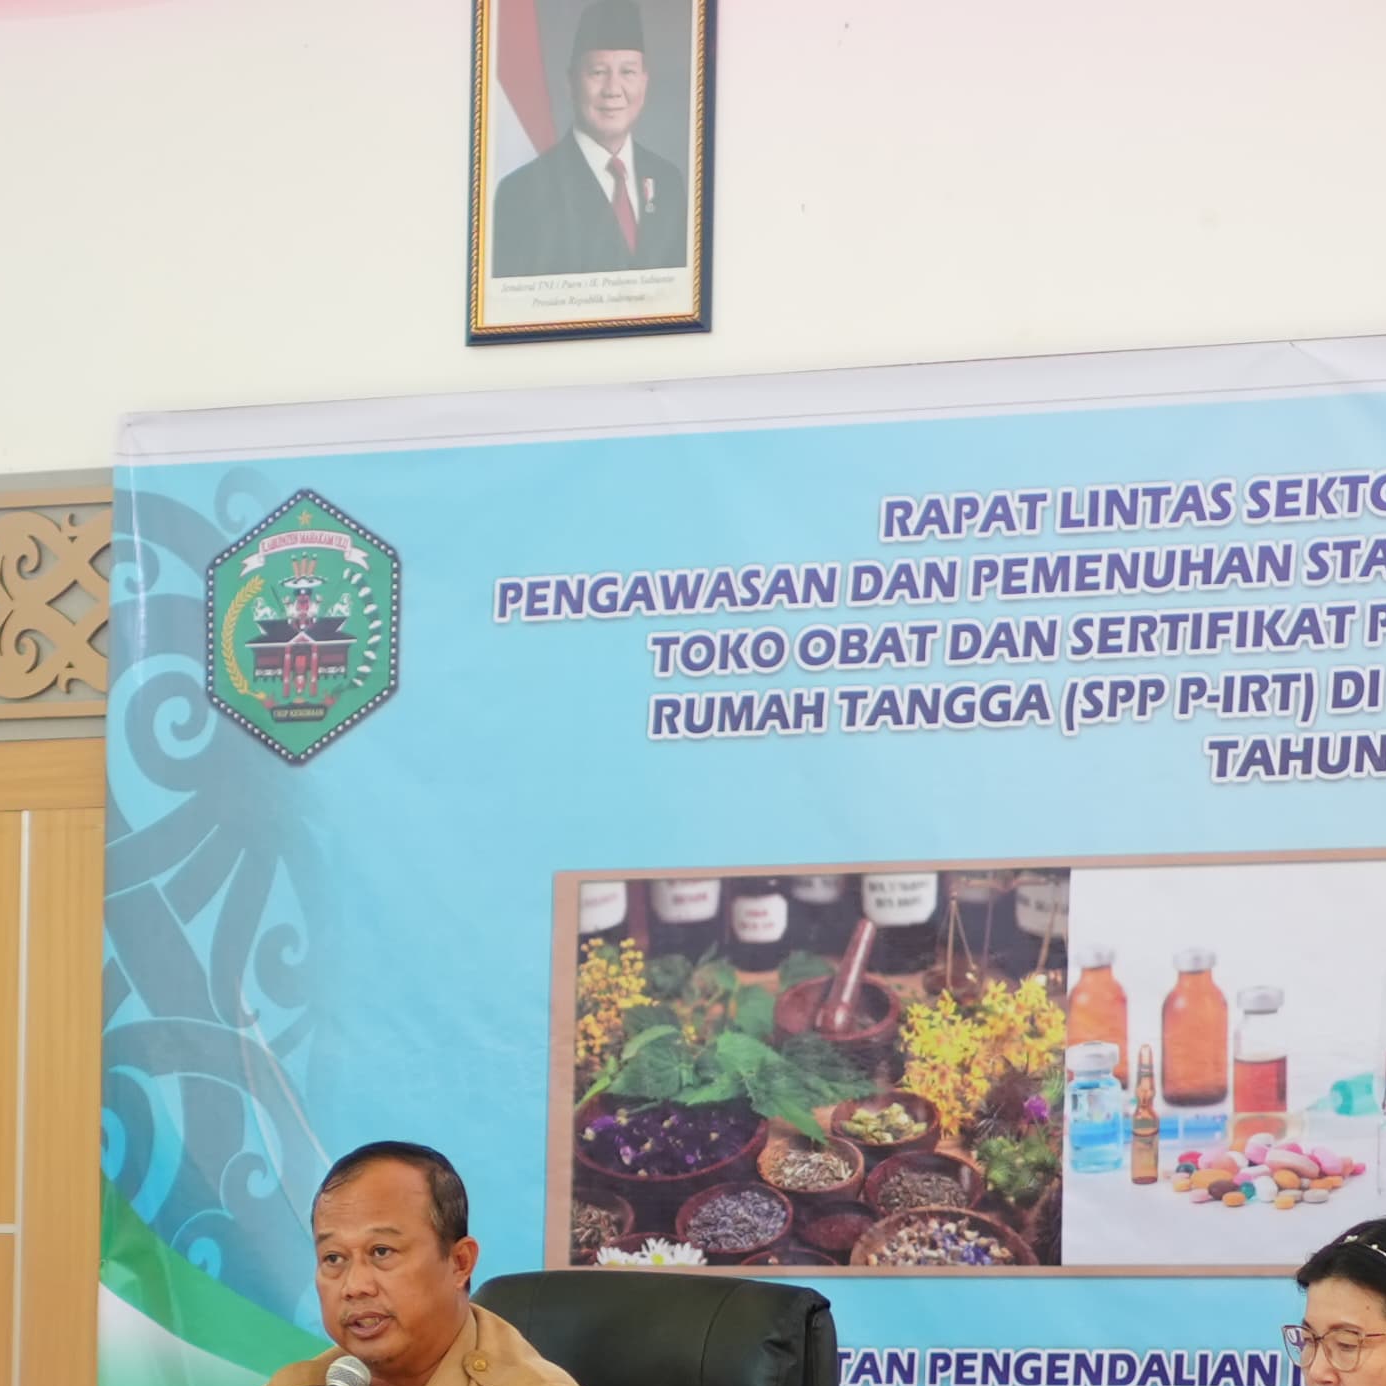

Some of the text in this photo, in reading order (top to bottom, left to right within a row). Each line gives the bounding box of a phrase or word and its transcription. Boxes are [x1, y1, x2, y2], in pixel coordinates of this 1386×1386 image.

[885, 493, 1047, 537] RAPAT
[1061, 483, 1231, 528] LINTAS
[499, 568, 836, 616] PENGAWASAN
[853, 562, 957, 600] DAN
[973, 544, 1292, 595] PEMENUHAN
[653, 632, 784, 672] TOKO
[800, 626, 937, 665] OBAT
[949, 620, 1057, 660] DAN
[1071, 606, 1355, 655] SERTIFIKAT
[653, 692, 824, 734] RUMAH
[840, 685, 1050, 726] TANGGA
[1066, 679, 1165, 730] (SPP
[1180, 673, 1313, 721] P-IRT)
[1333, 670, 1380, 708] DI
[929, 1352, 1278, 1386] PENGENDALIAN
